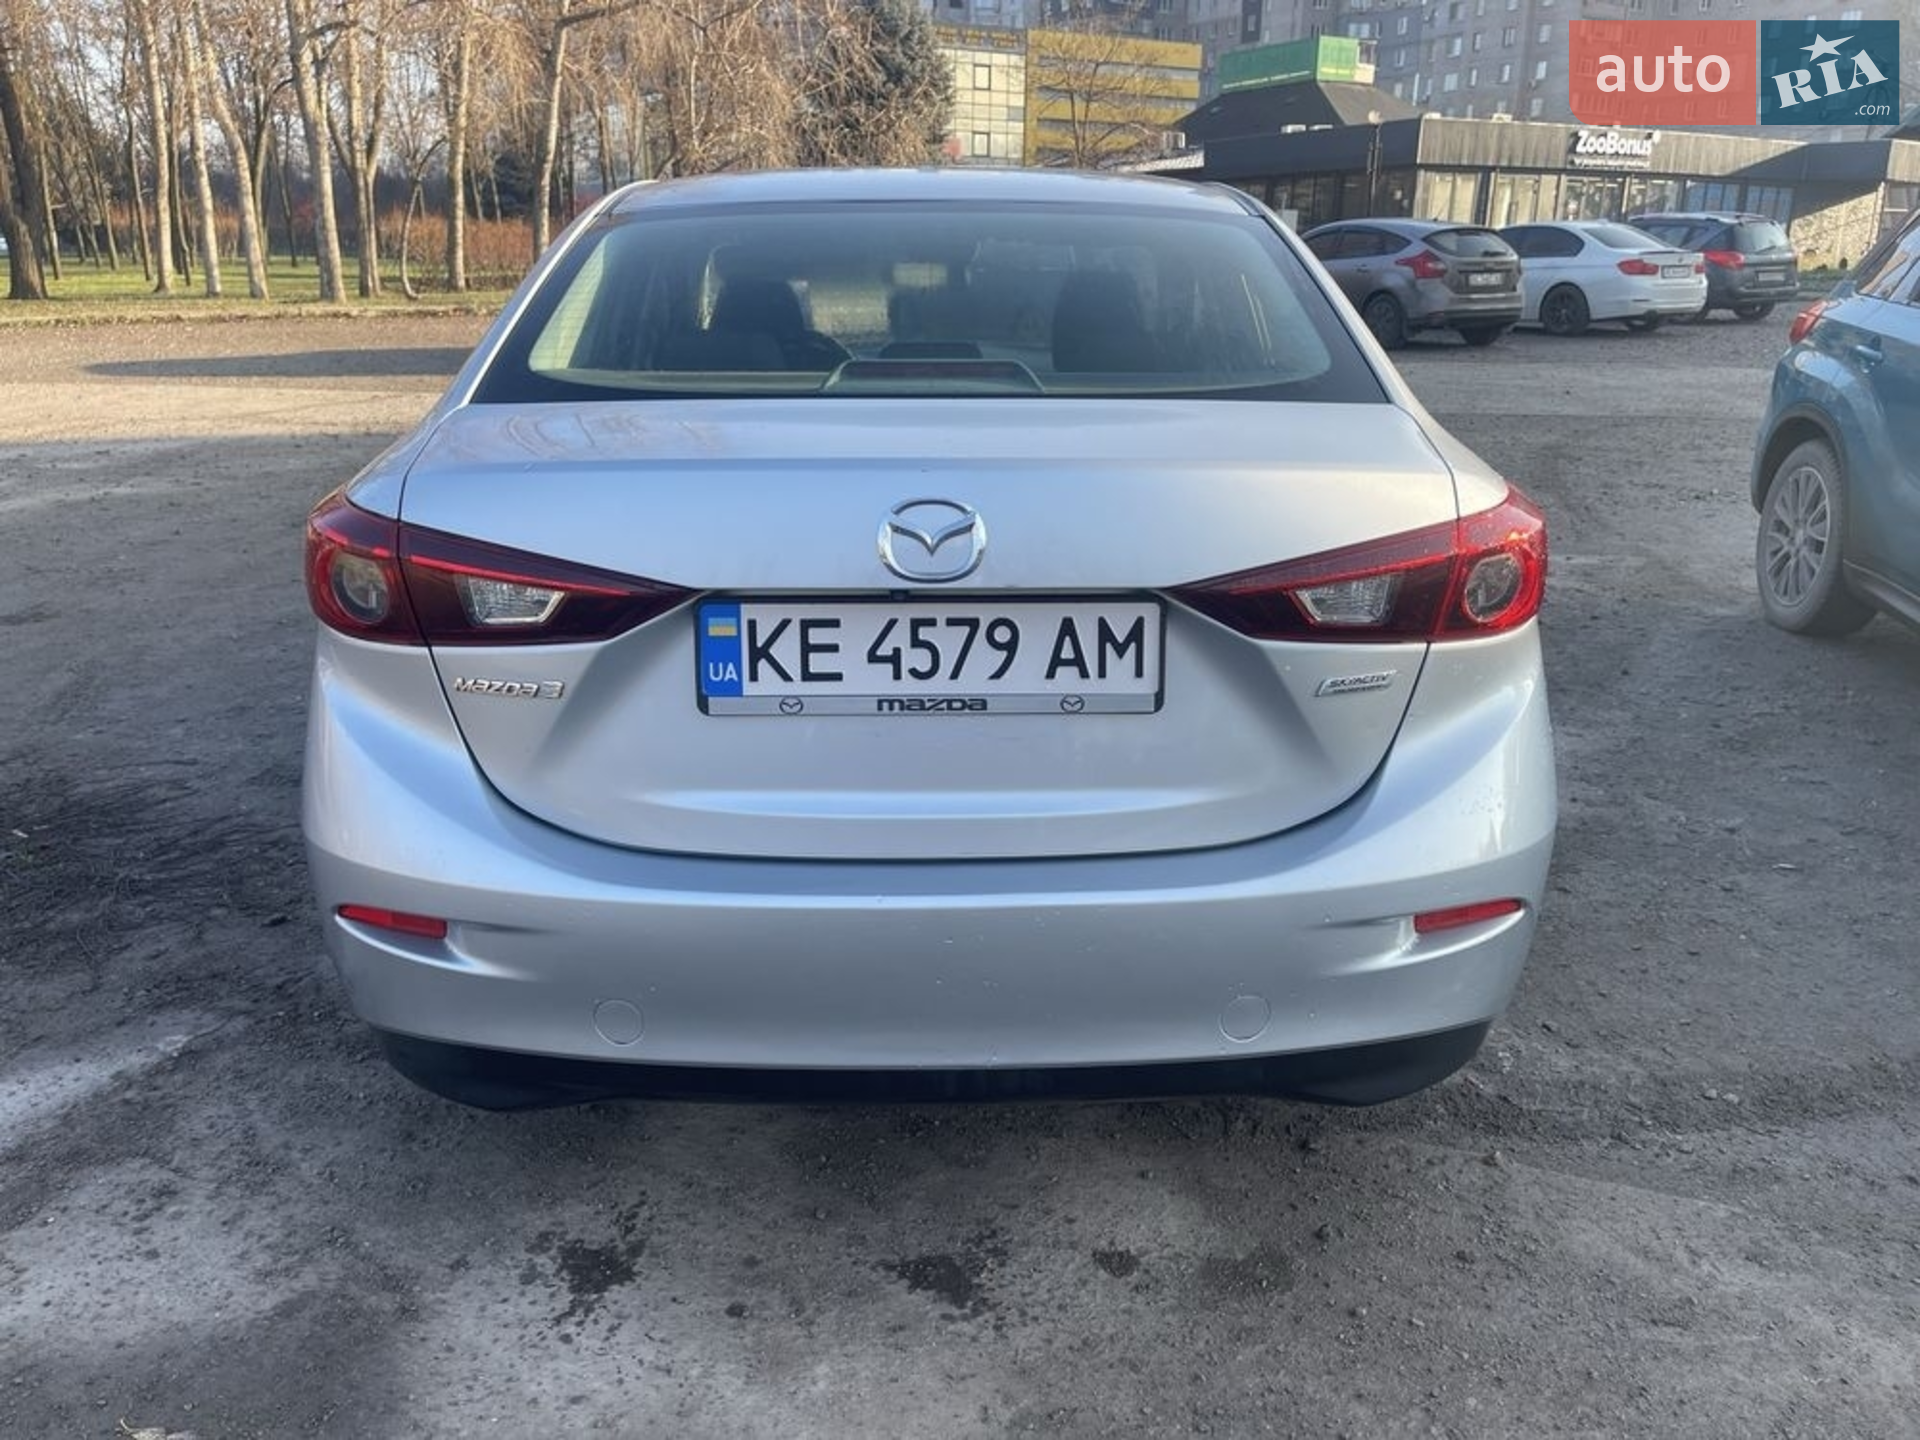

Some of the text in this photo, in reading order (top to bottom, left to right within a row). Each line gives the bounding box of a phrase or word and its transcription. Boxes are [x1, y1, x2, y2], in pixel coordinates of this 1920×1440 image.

[1576, 130, 1652, 155] ZooBonus
[747, 616, 1145, 682] KE 4579 AM
[709, 662, 738, 681] UA
